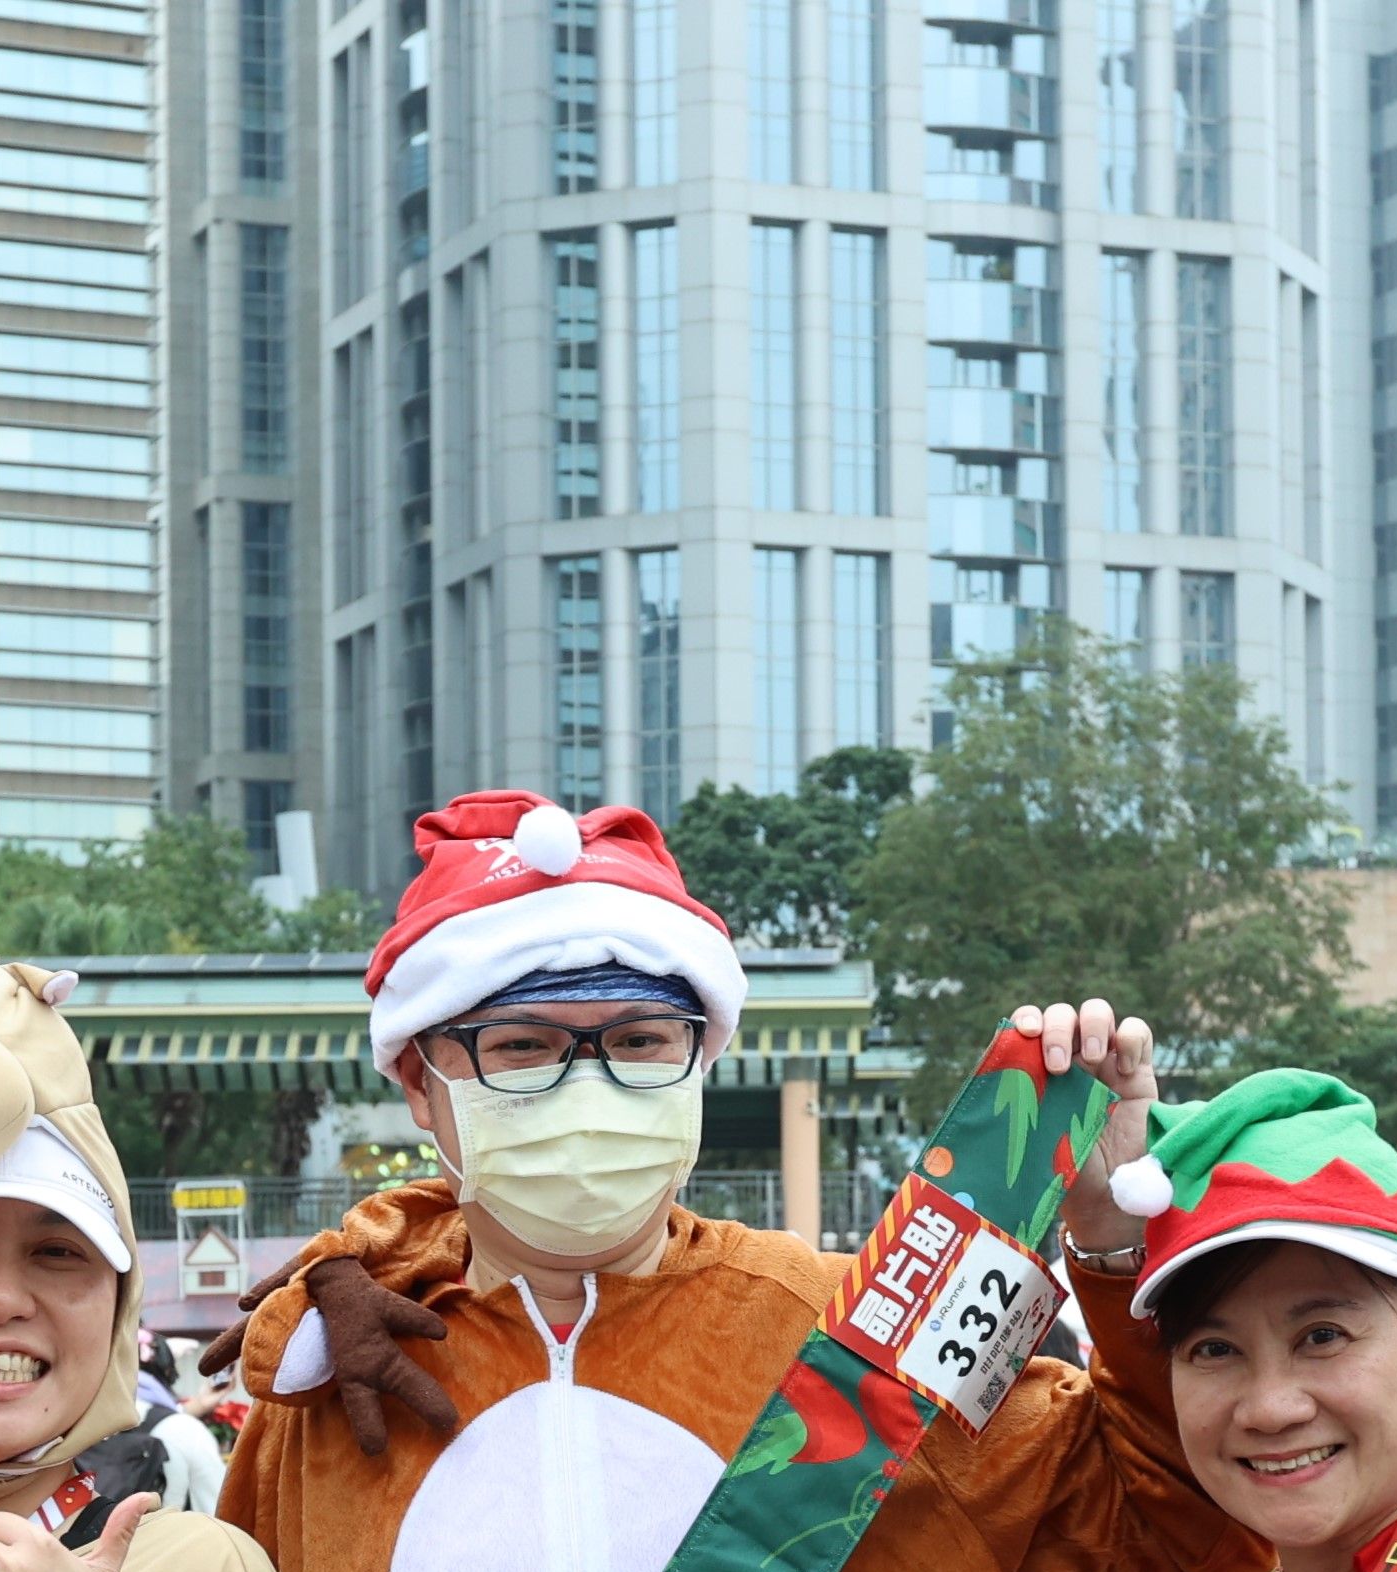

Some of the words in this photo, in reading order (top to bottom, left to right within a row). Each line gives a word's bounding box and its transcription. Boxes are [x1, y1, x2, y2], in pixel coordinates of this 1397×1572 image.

[62, 1171, 114, 1208] ARTENGO
[848, 1204, 958, 1346] 晶片貼
[938, 1269, 1022, 1377] 332
